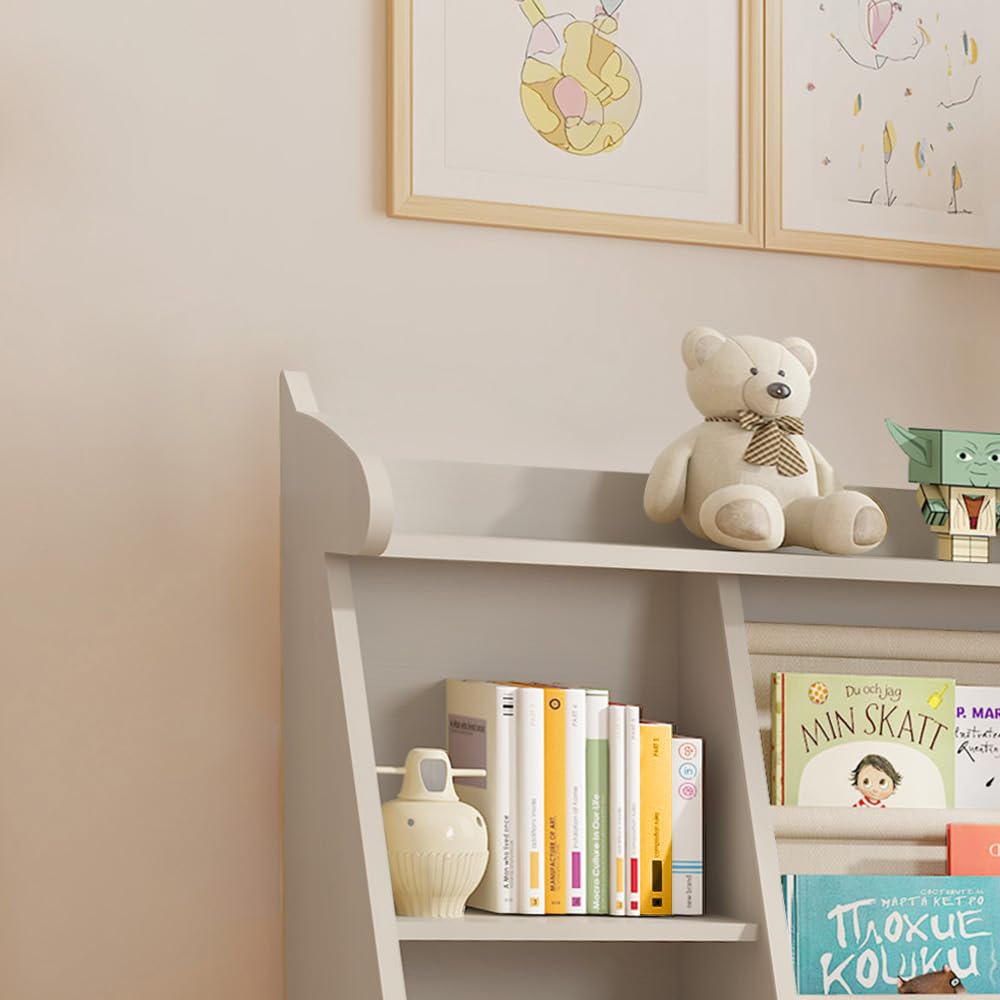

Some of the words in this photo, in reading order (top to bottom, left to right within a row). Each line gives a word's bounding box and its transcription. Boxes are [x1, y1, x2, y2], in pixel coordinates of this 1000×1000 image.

[845, 685, 862, 697] Du
[863, 684, 882, 695] och
[880, 687, 902, 701] jag
[956, 707, 967, 719] P.
[800, 706, 855, 753] MIN
[864, 703, 949, 751] SKATT
[591, 811, 601, 830] Our
[591, 878, 601, 911] Macro
